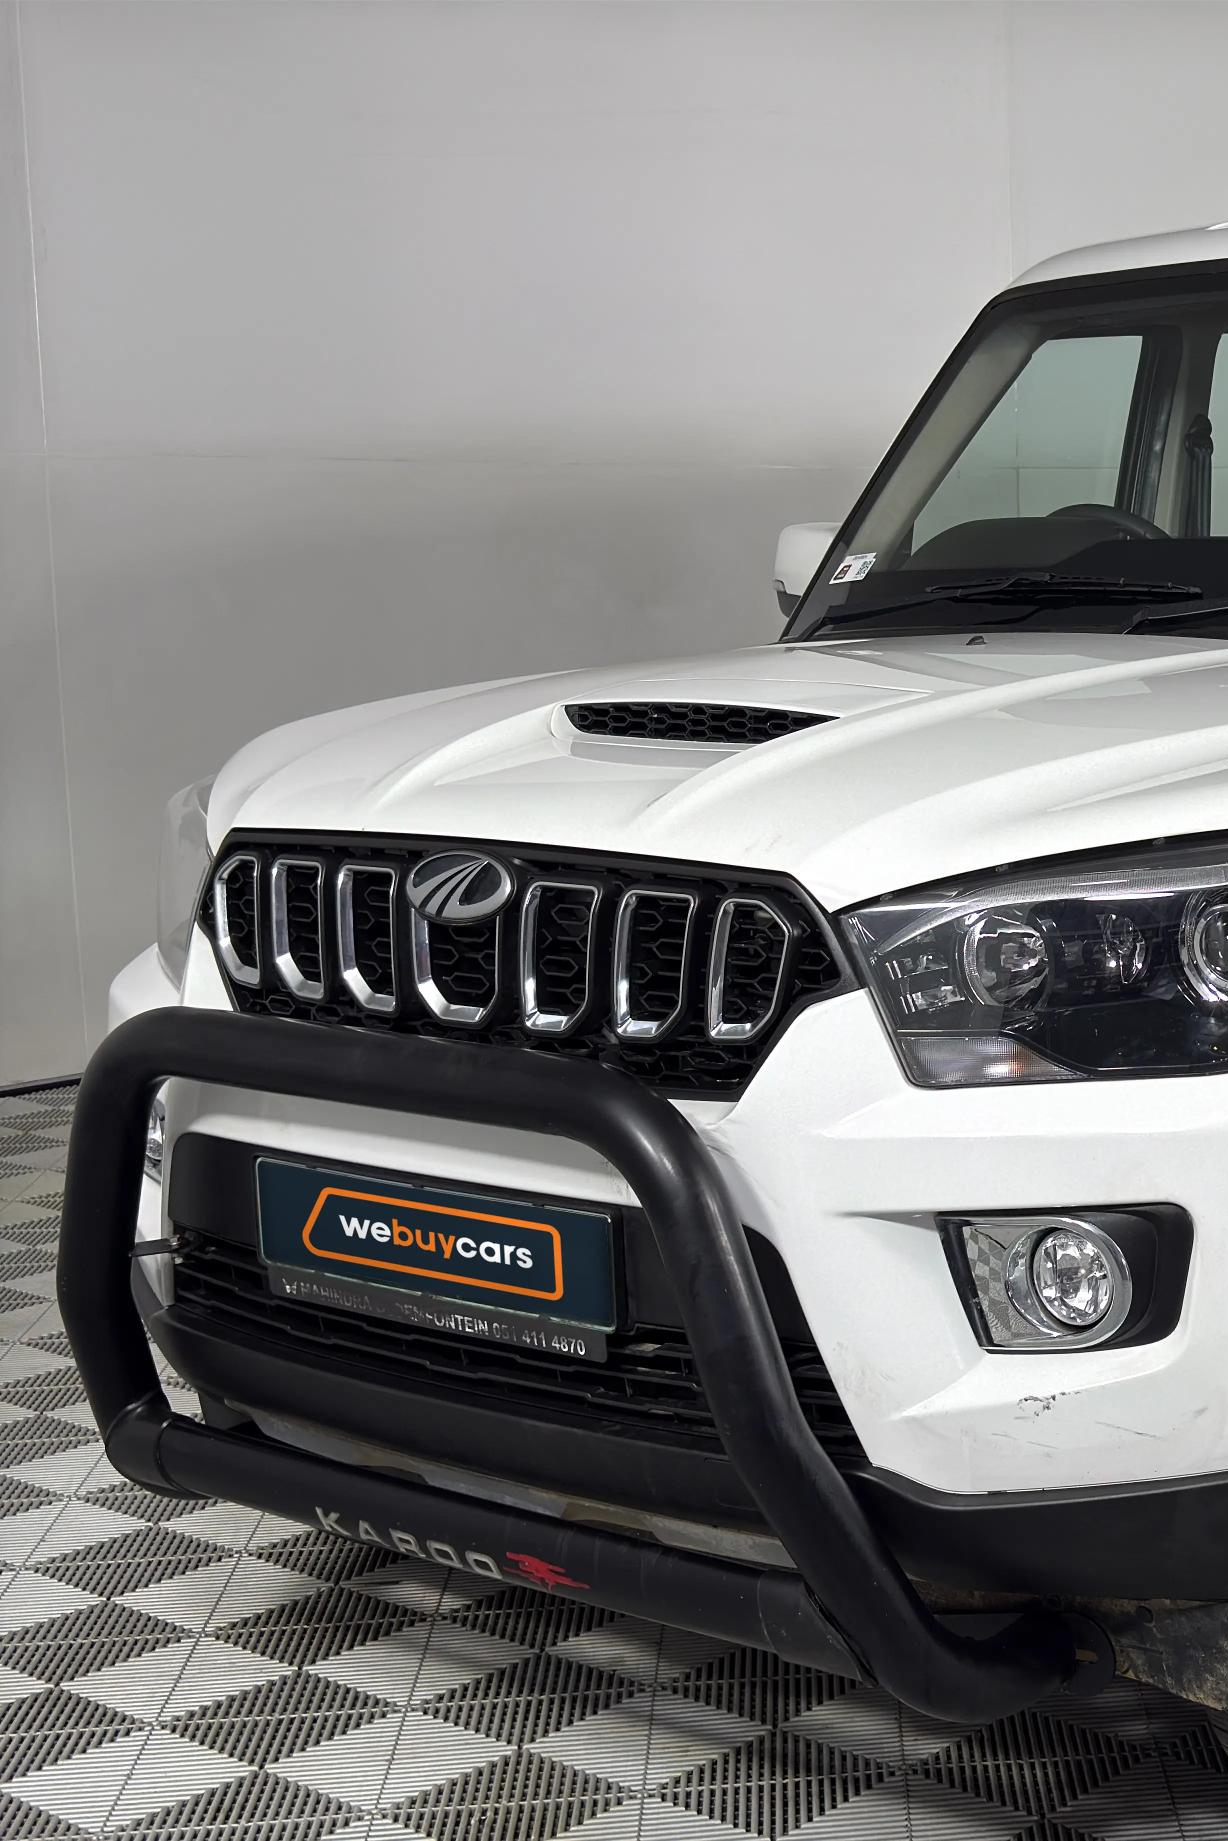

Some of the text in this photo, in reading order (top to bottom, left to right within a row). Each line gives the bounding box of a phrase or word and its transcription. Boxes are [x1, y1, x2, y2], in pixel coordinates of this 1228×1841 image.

[521, 1330, 547, 1348] 411
[551, 1335, 587, 1356] 4870
[315, 1505, 503, 1580] KAROO
